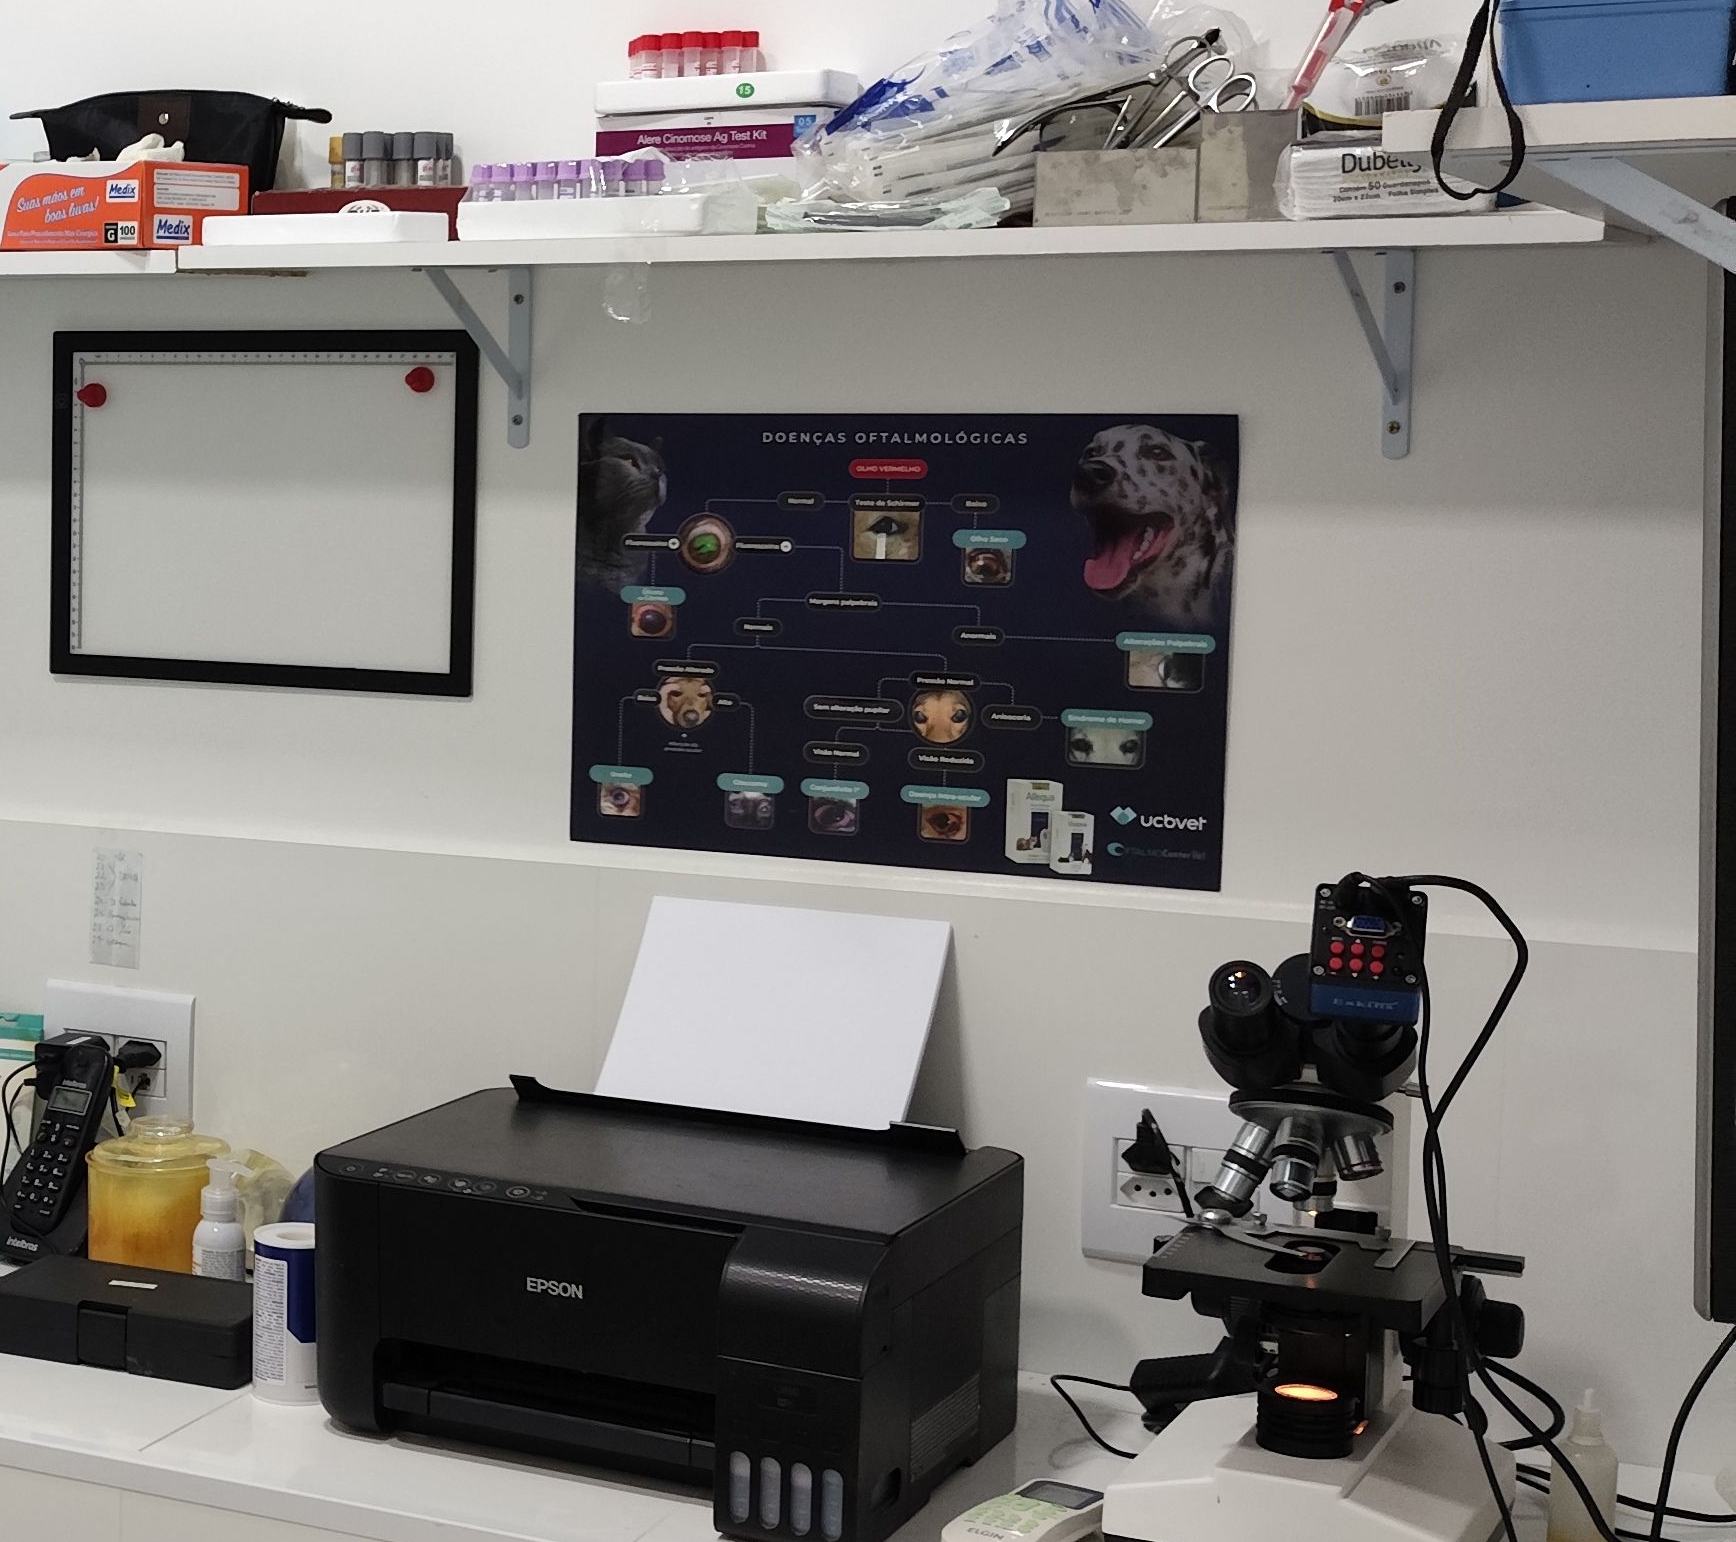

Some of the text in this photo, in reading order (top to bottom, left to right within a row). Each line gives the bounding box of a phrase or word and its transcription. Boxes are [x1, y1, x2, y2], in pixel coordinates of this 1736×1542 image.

[739, 86, 751, 95] 15
[637, 129, 766, 145] Alere Cinomose Ag Test Kit
[1342, 152, 1422, 173] Dube
[109, 183, 136, 195] Medix
[17, 186, 85, 213] Suas mãos em
[44, 196, 100, 225] boas luvas!
[119, 225, 136, 236] 100
[156, 219, 190, 235] Medix
[107, 230, 116, 242] G
[763, 430, 1028, 446] DOENÇAS OFTALMOLÓGICAS
[1139, 813, 1207, 832] ucbvet
[526, 1276, 584, 1300] EPSON
